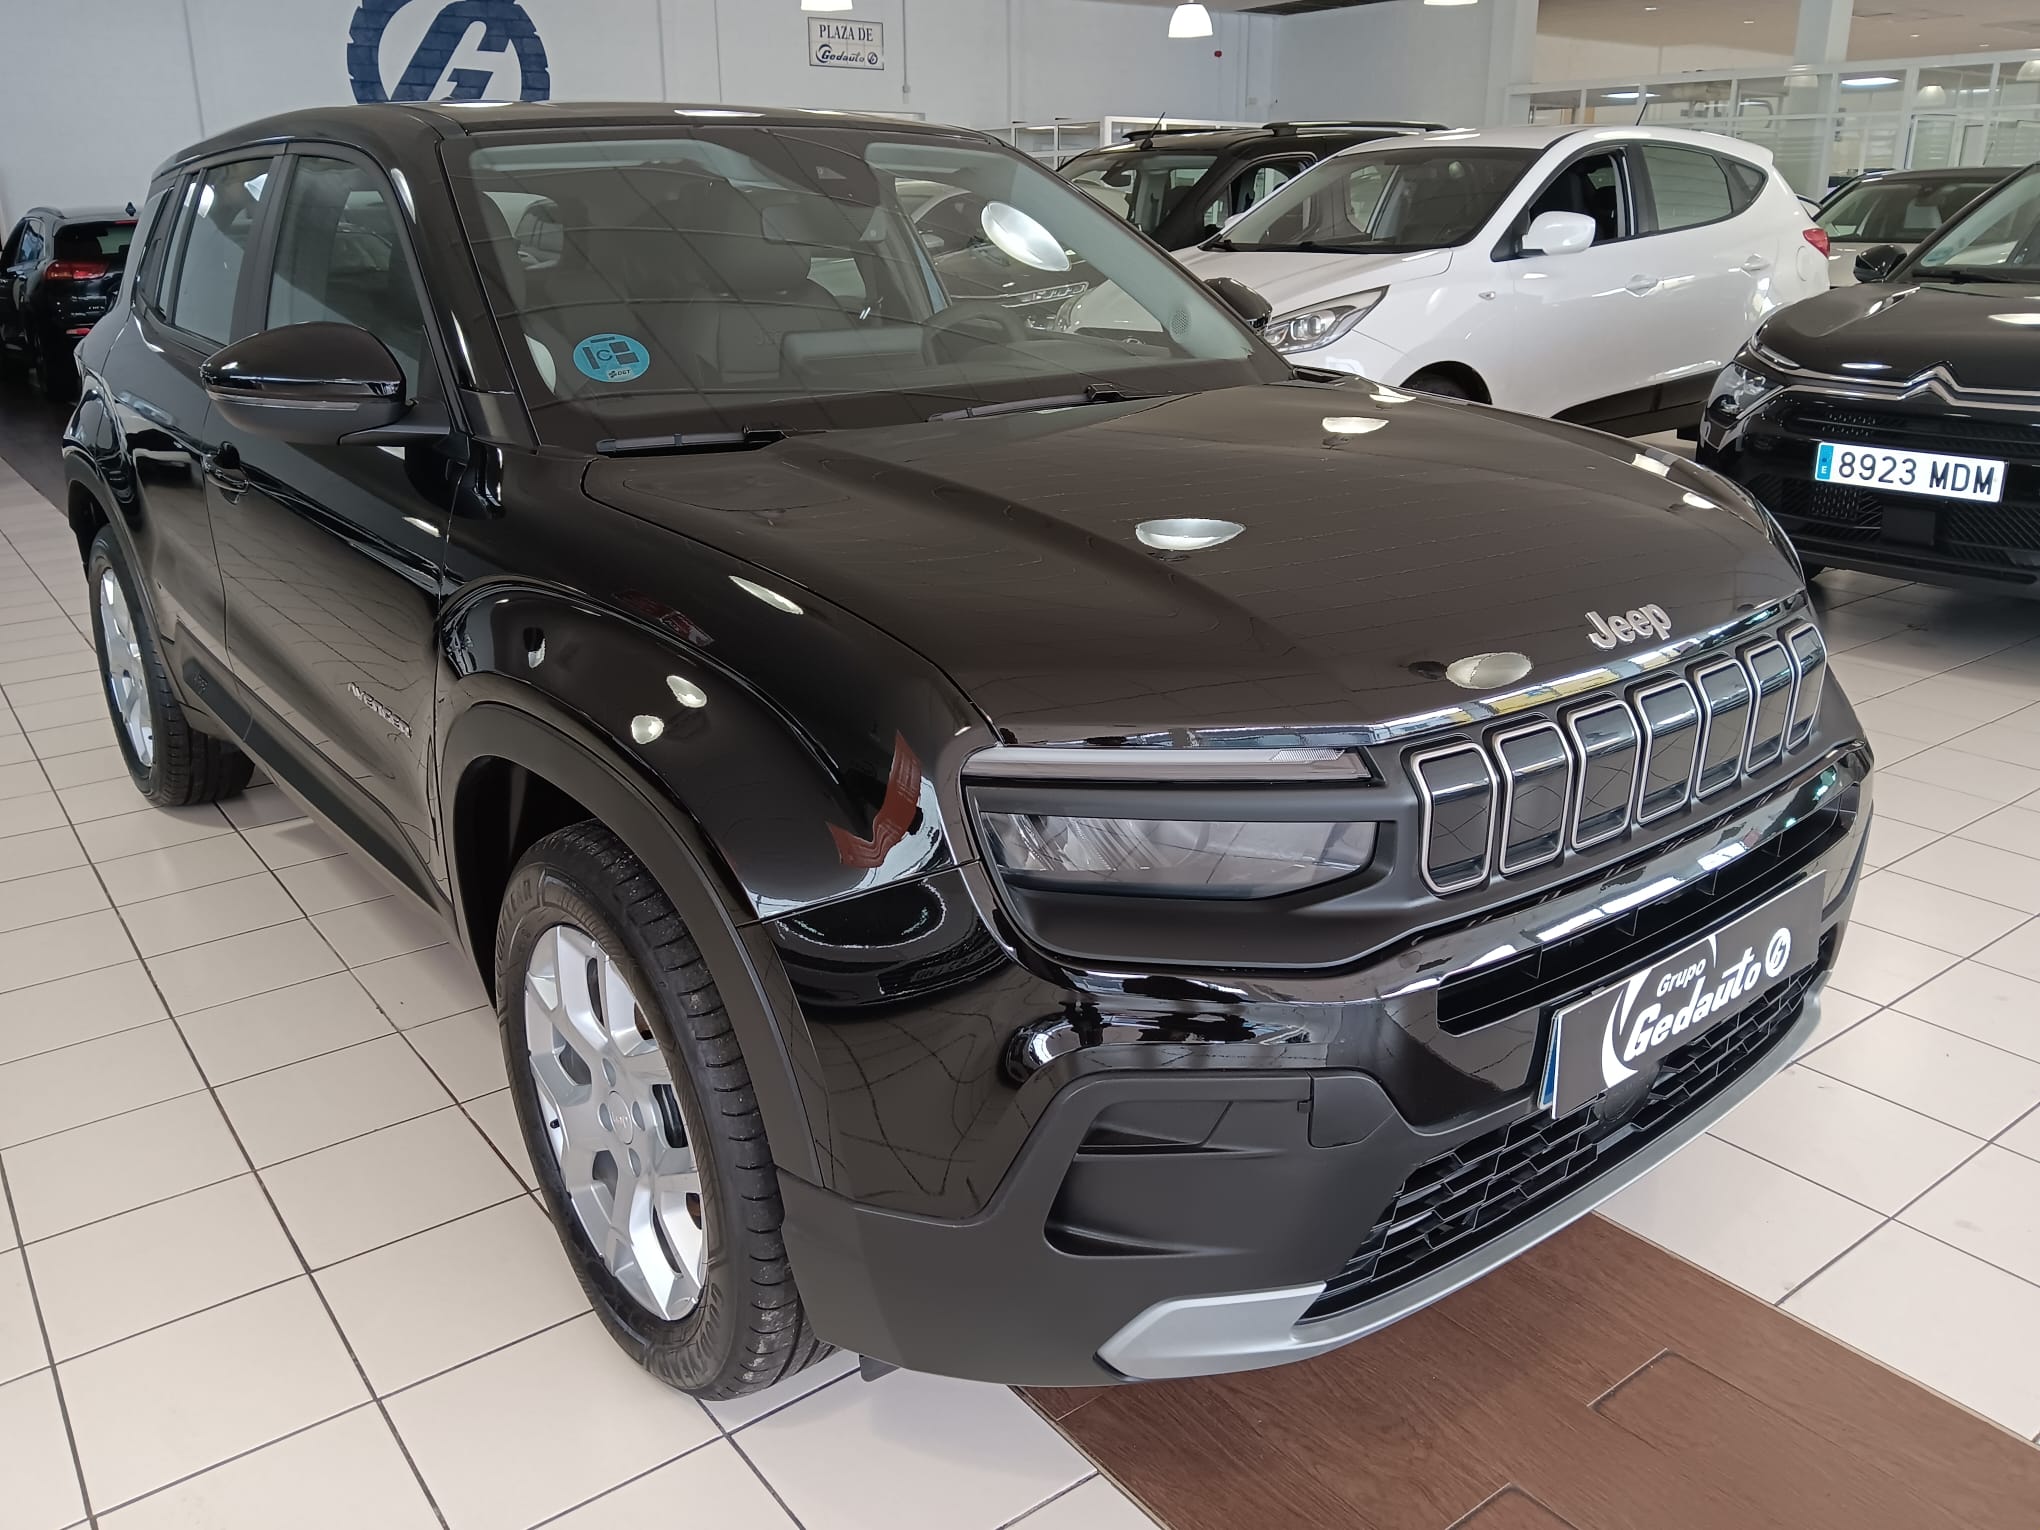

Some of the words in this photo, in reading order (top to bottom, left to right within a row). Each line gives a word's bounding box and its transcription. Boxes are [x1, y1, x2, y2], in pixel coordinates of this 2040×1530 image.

[819, 24, 855, 41] PLAZA
[858, 27, 874, 42] DE
[1820, 465, 1828, 474] E
[1838, 451, 1917, 486] 8923
[1928, 460, 1995, 496] MDM
[1585, 603, 1672, 651] Jeep
[1656, 958, 1707, 997] Grupo
[1623, 946, 1762, 1062] Gedauto
